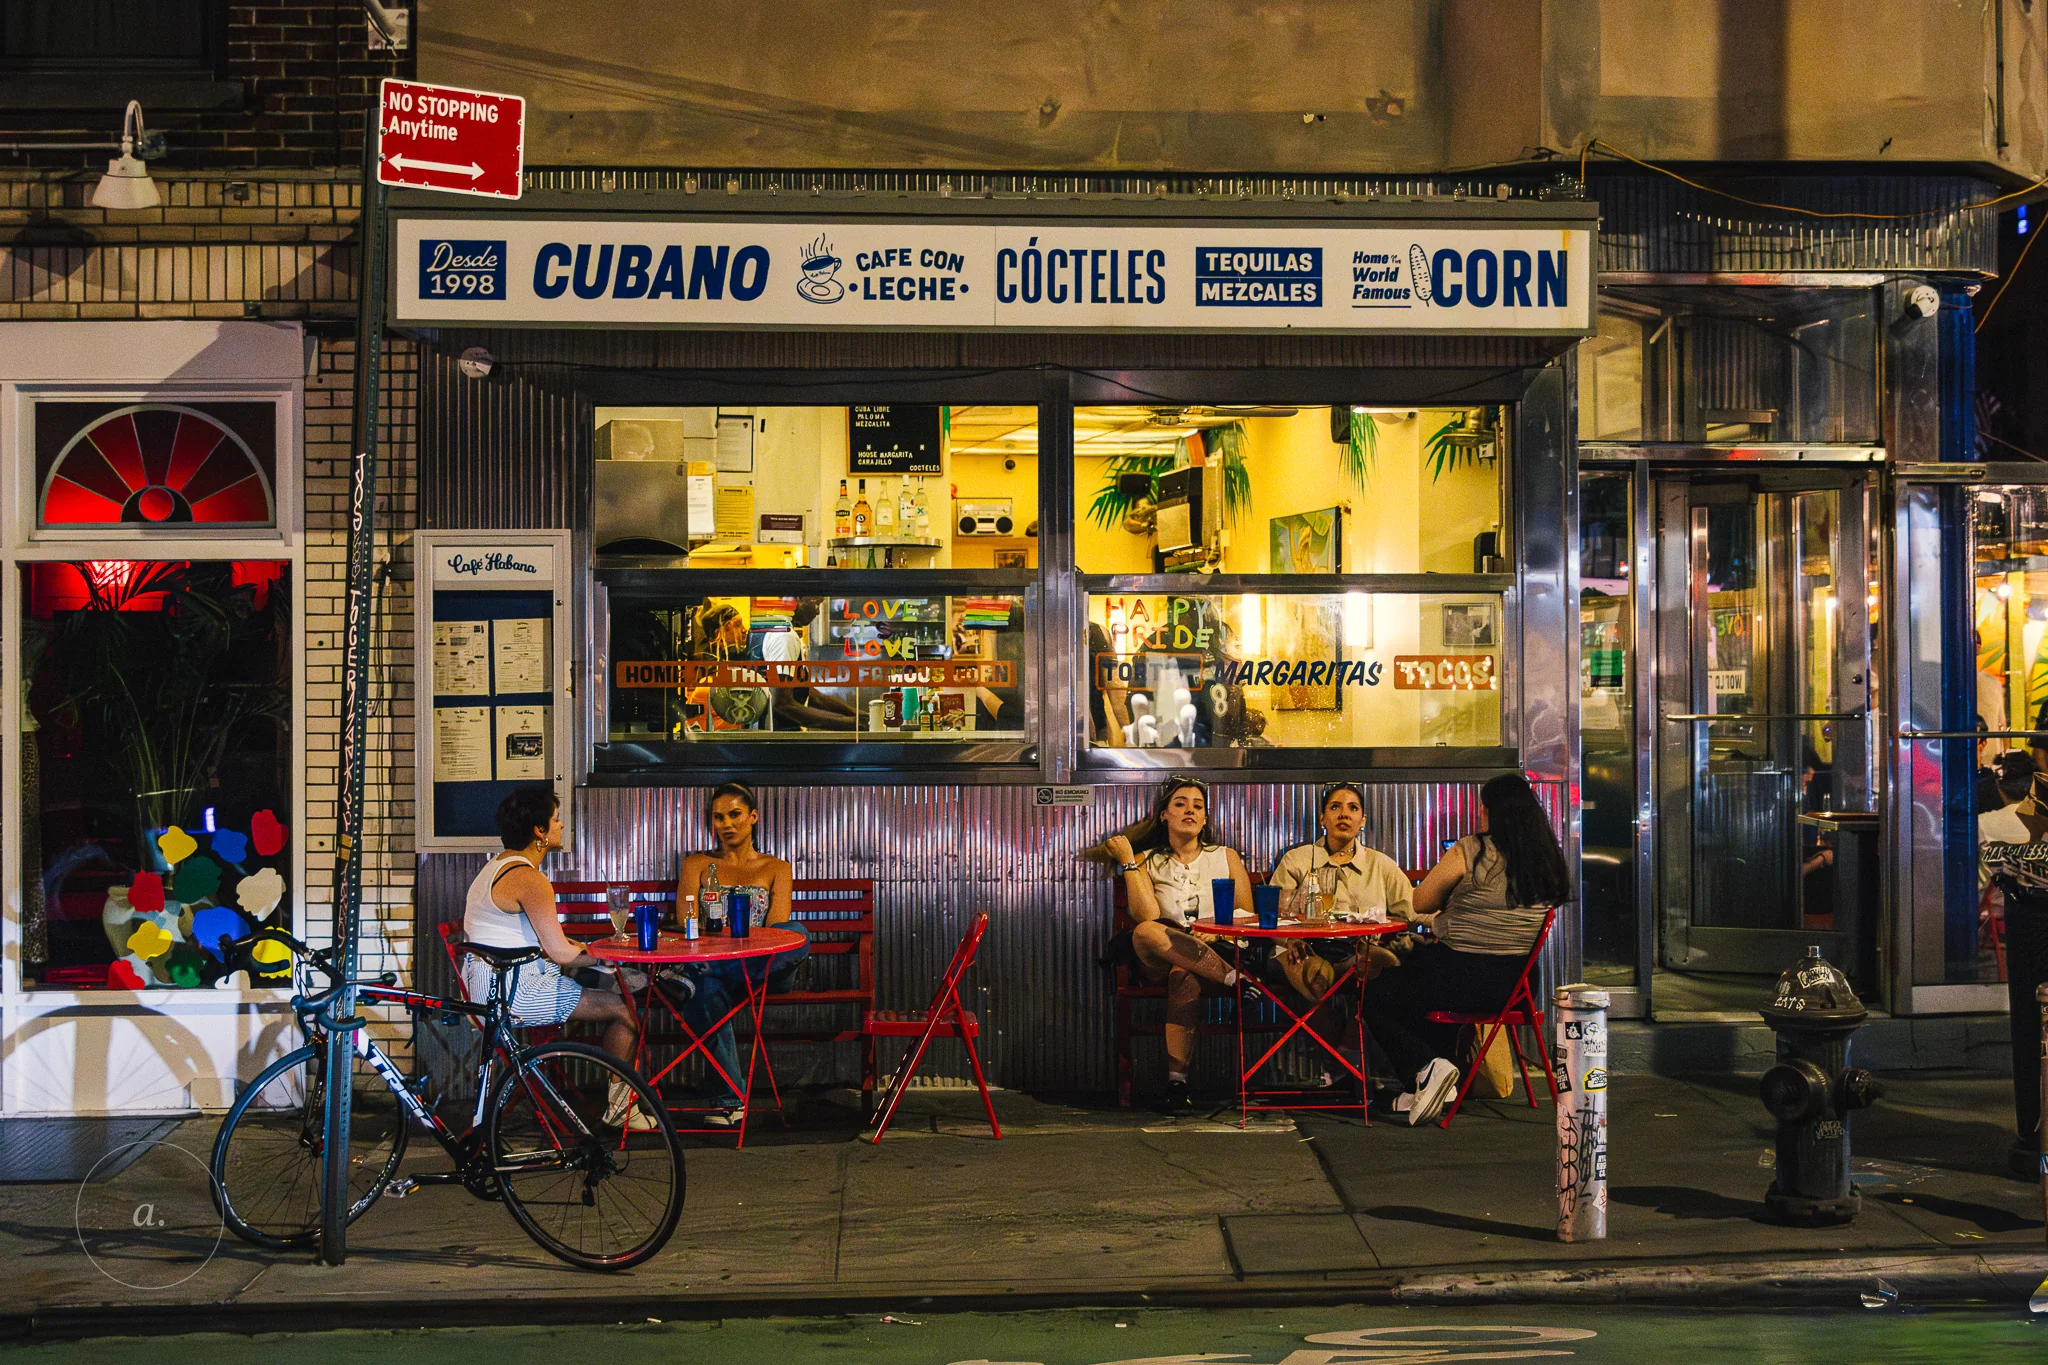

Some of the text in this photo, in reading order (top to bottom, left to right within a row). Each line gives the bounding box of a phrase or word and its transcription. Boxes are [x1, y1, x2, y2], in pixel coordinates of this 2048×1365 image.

[389, 91, 498, 123] NO STOPPING
[389, 116, 458, 142] Anytime
[426, 241, 498, 272] Desde
[855, 248, 965, 273] CAFE CON
[1206, 252, 1313, 276] TEQUILAS
[1352, 251, 1389, 264] Home
[532, 242, 770, 301] CUBANO
[996, 236, 1166, 305] CÓCTELES
[1352, 267, 1400, 282] World
[1431, 249, 1568, 308] CORN
[431, 274, 494, 295] 1998
[863, 277, 956, 301] LECHE
[1201, 282, 1317, 301] MEZCALES
[1352, 284, 1411, 299] Famous
[448, 553, 537, 575] Café Habana
[843, 599, 921, 621] LOVE
[1106, 597, 1210, 629] HAPPY
[1111, 622, 1214, 649] PRIDE
[843, 637, 917, 659] LOVE
[626, 665, 1008, 683] HOME OF THE WORLD FAMOUS CORN
[1214, 660, 1382, 687] MARGARITAS
[1402, 661, 1492, 685] TACOS
[1210, 683, 1228, 717] 8
[366, 1042, 436, 1130] TREK
